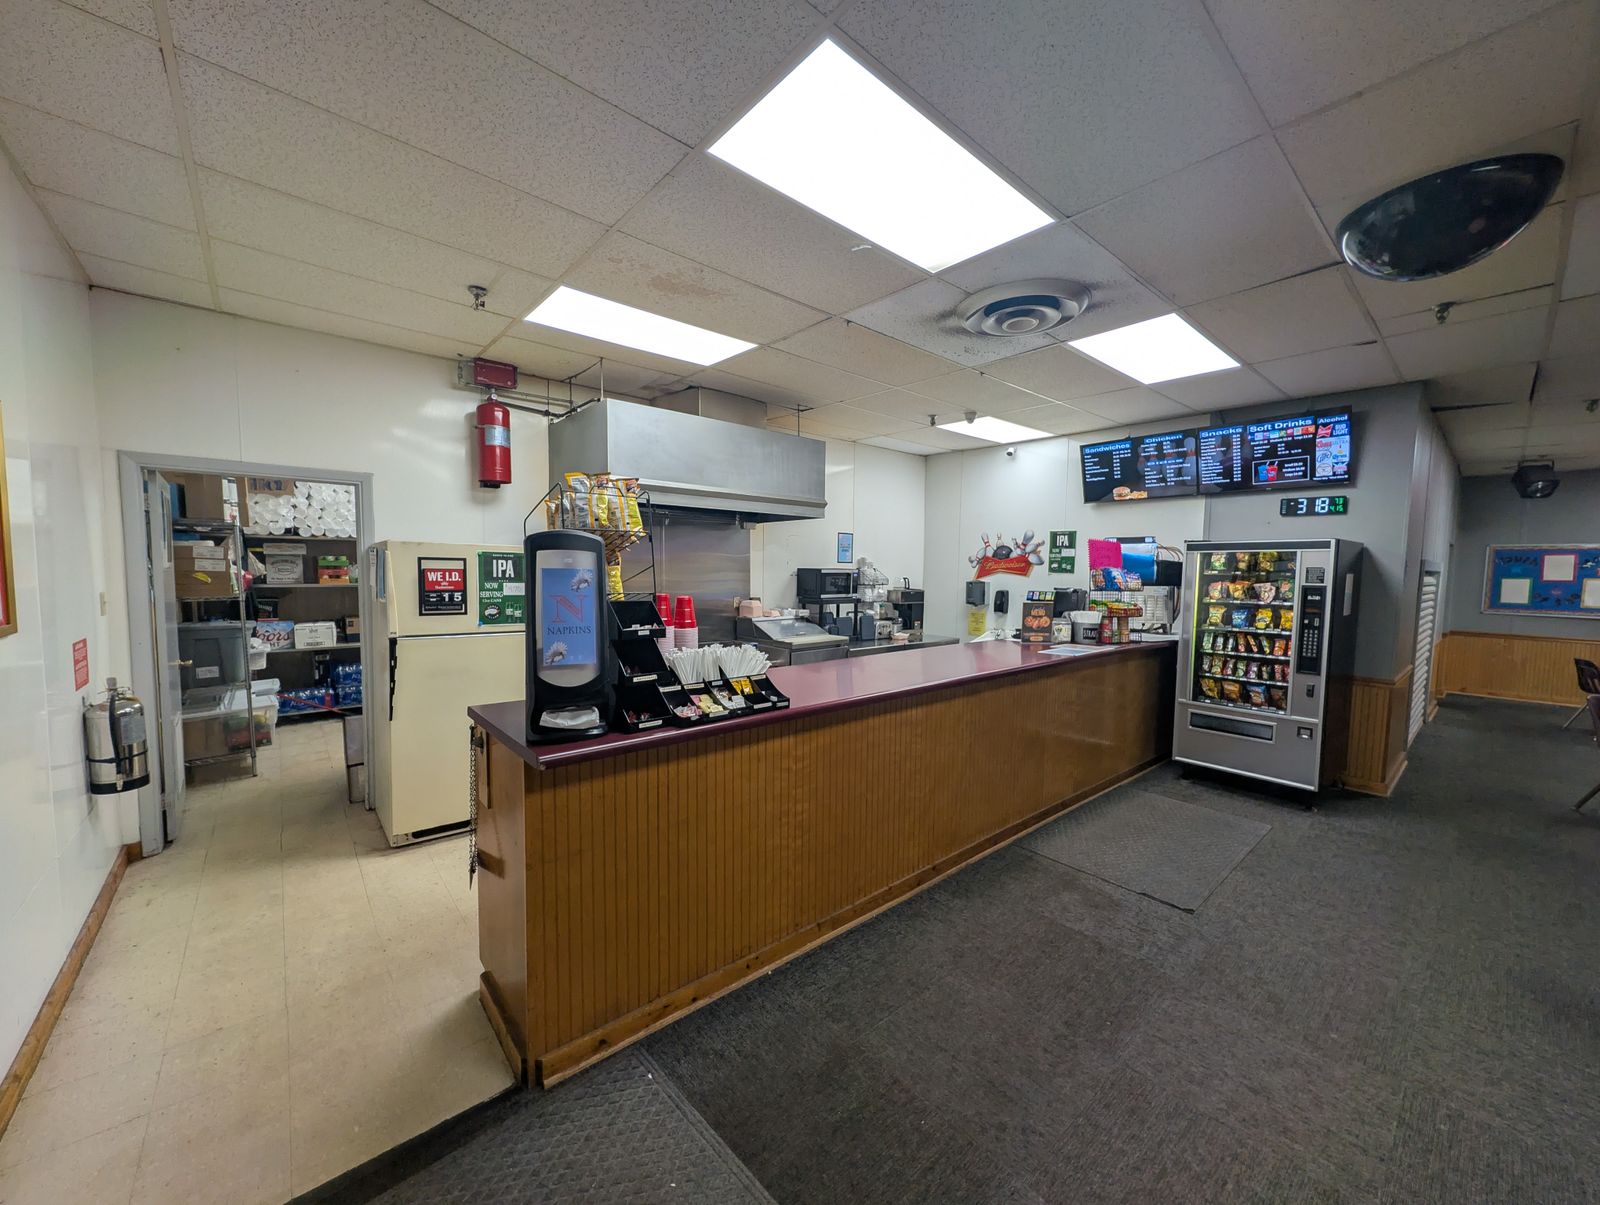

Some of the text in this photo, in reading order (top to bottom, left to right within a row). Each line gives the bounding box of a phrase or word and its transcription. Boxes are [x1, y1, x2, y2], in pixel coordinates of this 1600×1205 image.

[1318, 414, 1348, 424] Alcohol
[1250, 419, 1312, 433] Soft Drinks
[1201, 427, 1243, 437] Snacks
[1145, 434, 1183, 443] Chicken
[1085, 443, 1130, 454] Sandwiches
[1056, 535, 1069, 546] IPA
[493, 559, 514, 578] IPA
[427, 572, 461, 581] WE I.D.
[550, 594, 589, 624] N
[547, 625, 592, 636] NAPKINS
